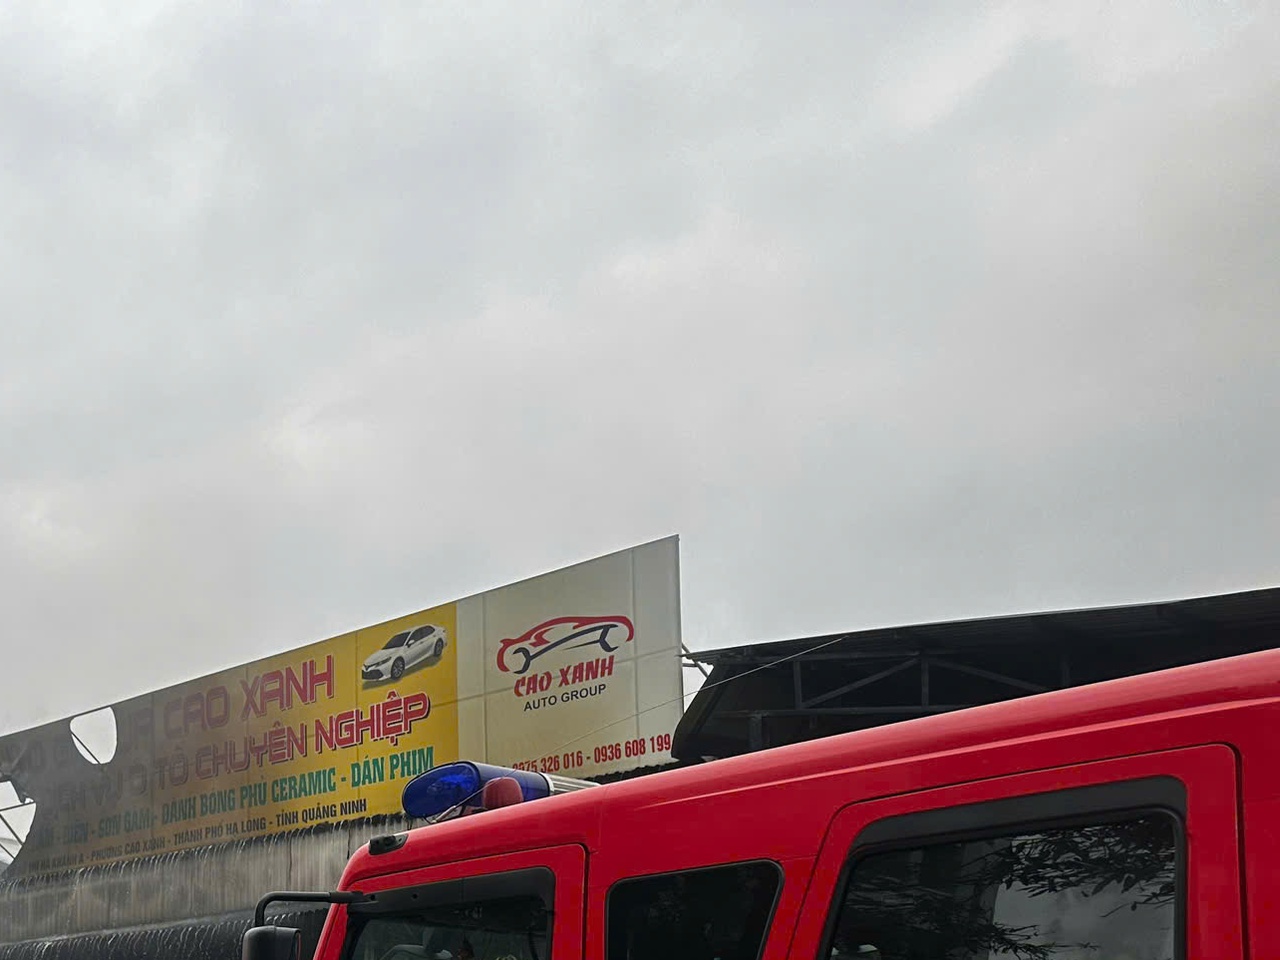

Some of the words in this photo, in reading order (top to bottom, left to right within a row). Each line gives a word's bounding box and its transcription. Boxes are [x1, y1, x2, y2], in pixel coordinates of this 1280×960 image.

[241, 654, 334, 721] XANH
[514, 671, 552, 698] CAO
[559, 655, 615, 688] XANH
[524, 695, 557, 712] AUTO
[561, 683, 607, 703] GROUP
[195, 721, 307, 780] CHUYÊN
[315, 689, 431, 752] NGHIỆP
[540, 754, 560, 773] 326
[563, 750, 583, 770] 016
[594, 742, 622, 764] 0936
[625, 738, 646, 758] 608
[650, 733, 671, 753] 199
[271, 767, 337, 802] CERAMIC
[351, 755, 386, 788] DÁN
[389, 746, 434, 780] PHIM
[241, 817, 266, 832] LONG
[301, 801, 337, 825] QUẢNG
[340, 798, 367, 817] NINH
